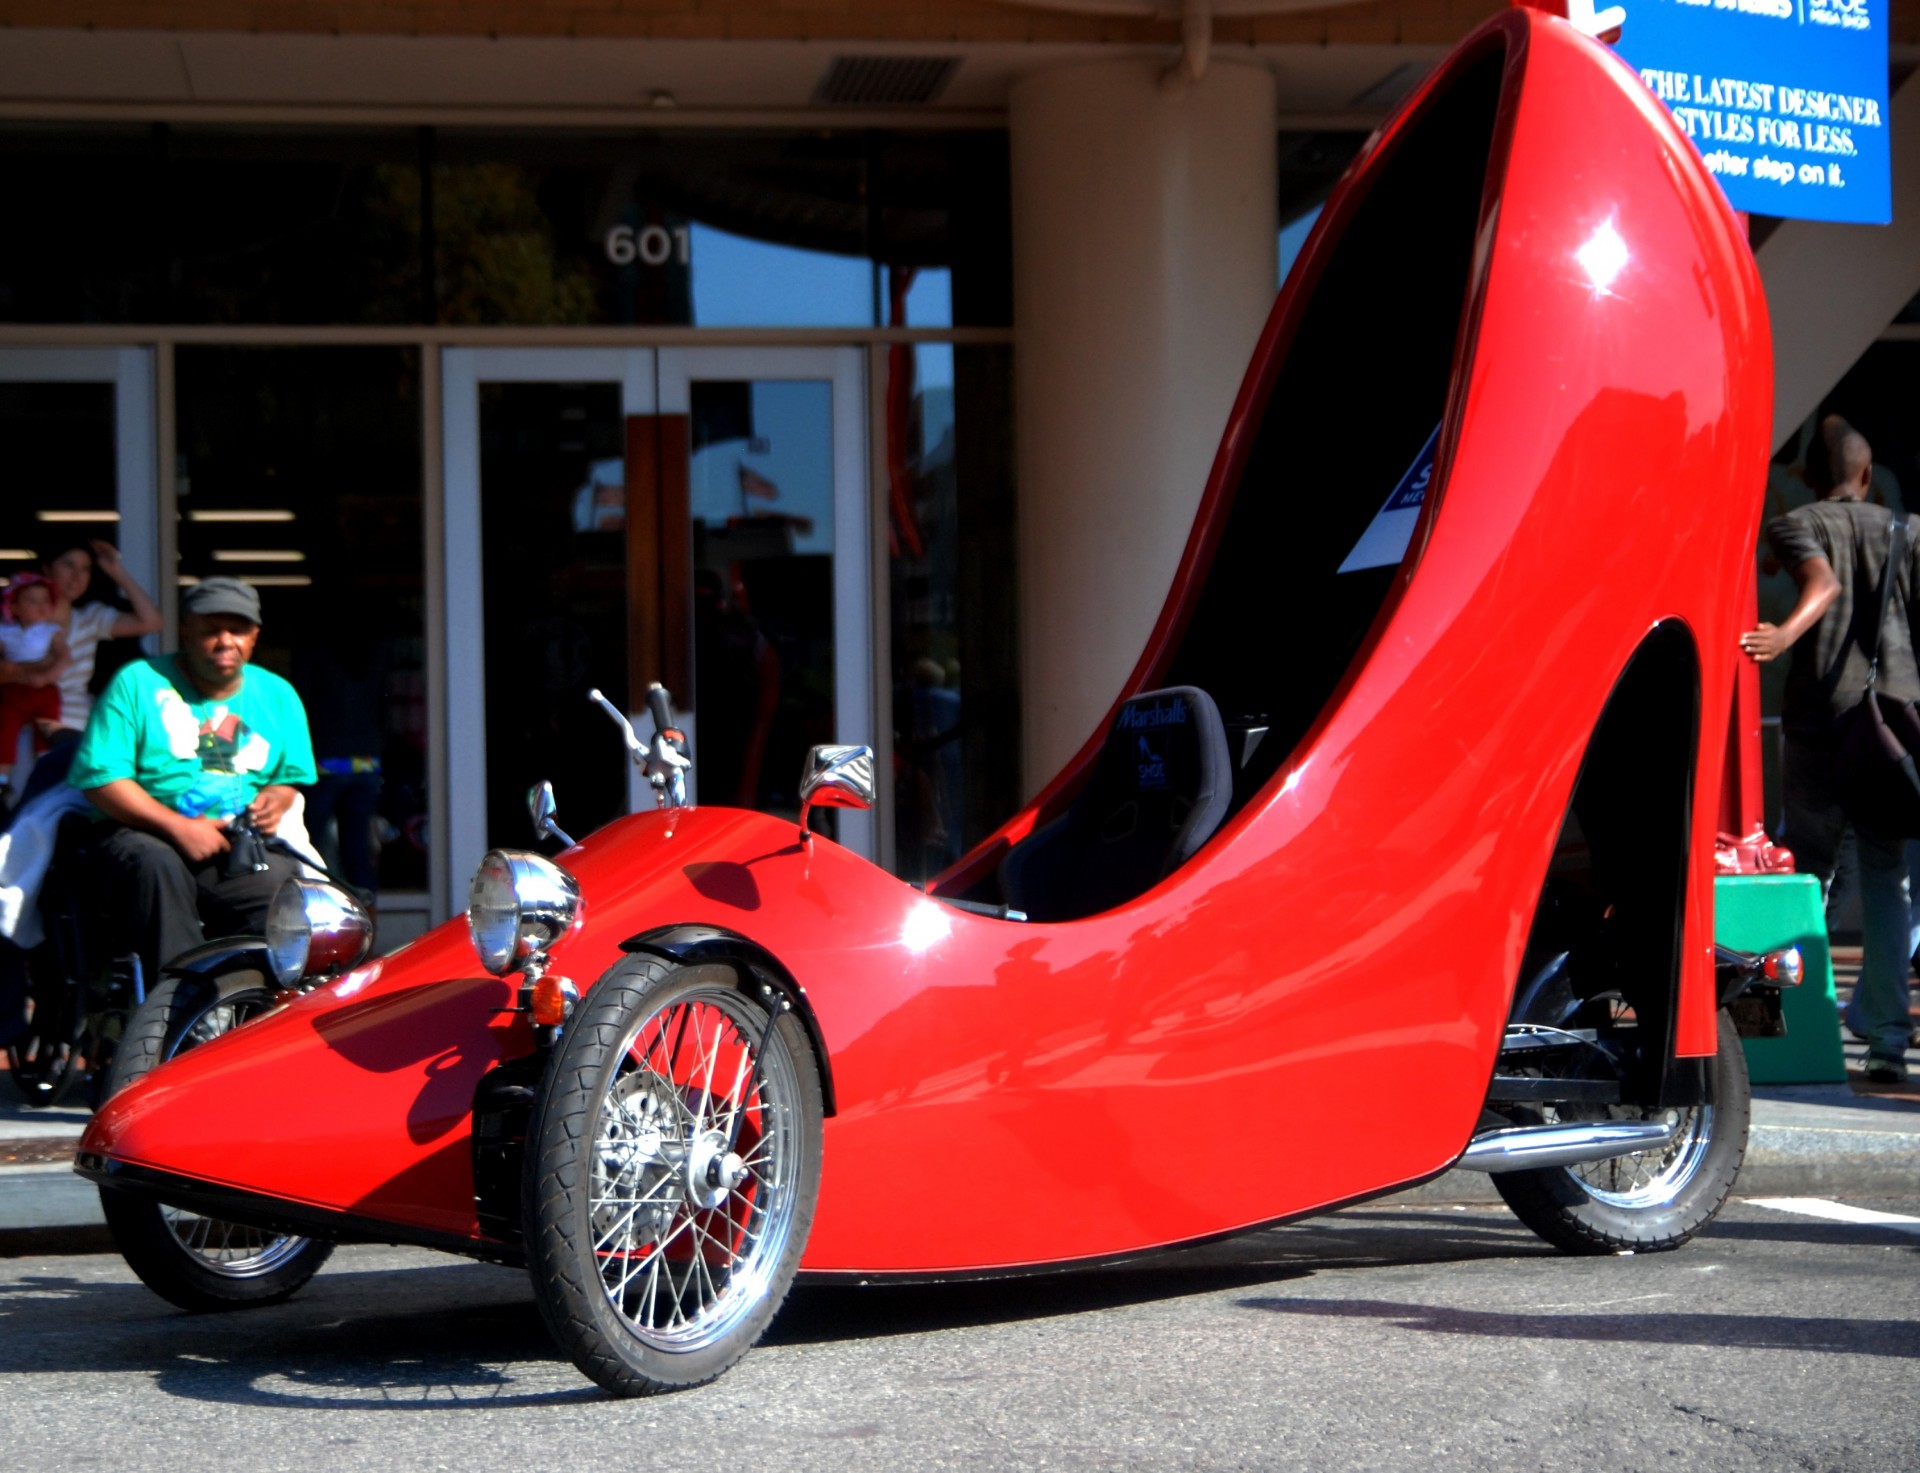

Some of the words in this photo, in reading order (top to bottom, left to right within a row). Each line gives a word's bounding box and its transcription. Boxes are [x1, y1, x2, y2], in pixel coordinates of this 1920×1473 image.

[1640, 68, 1690, 102] THE
[1693, 75, 1774, 112] LATEST
[1778, 86, 1881, 127] DESIGNER
[1672, 106, 1755, 143] STYLES
[1758, 117, 1802, 149] FOR
[1804, 123, 1859, 157] LESS.
[1753, 155, 1795, 186] step
[1799, 163, 1825, 185] on
[1828, 162, 1846, 188] it.
[607, 224, 690, 266] 601
[1116, 698, 1187, 731] Marshalls
[1137, 762, 1167, 779] SHOE
